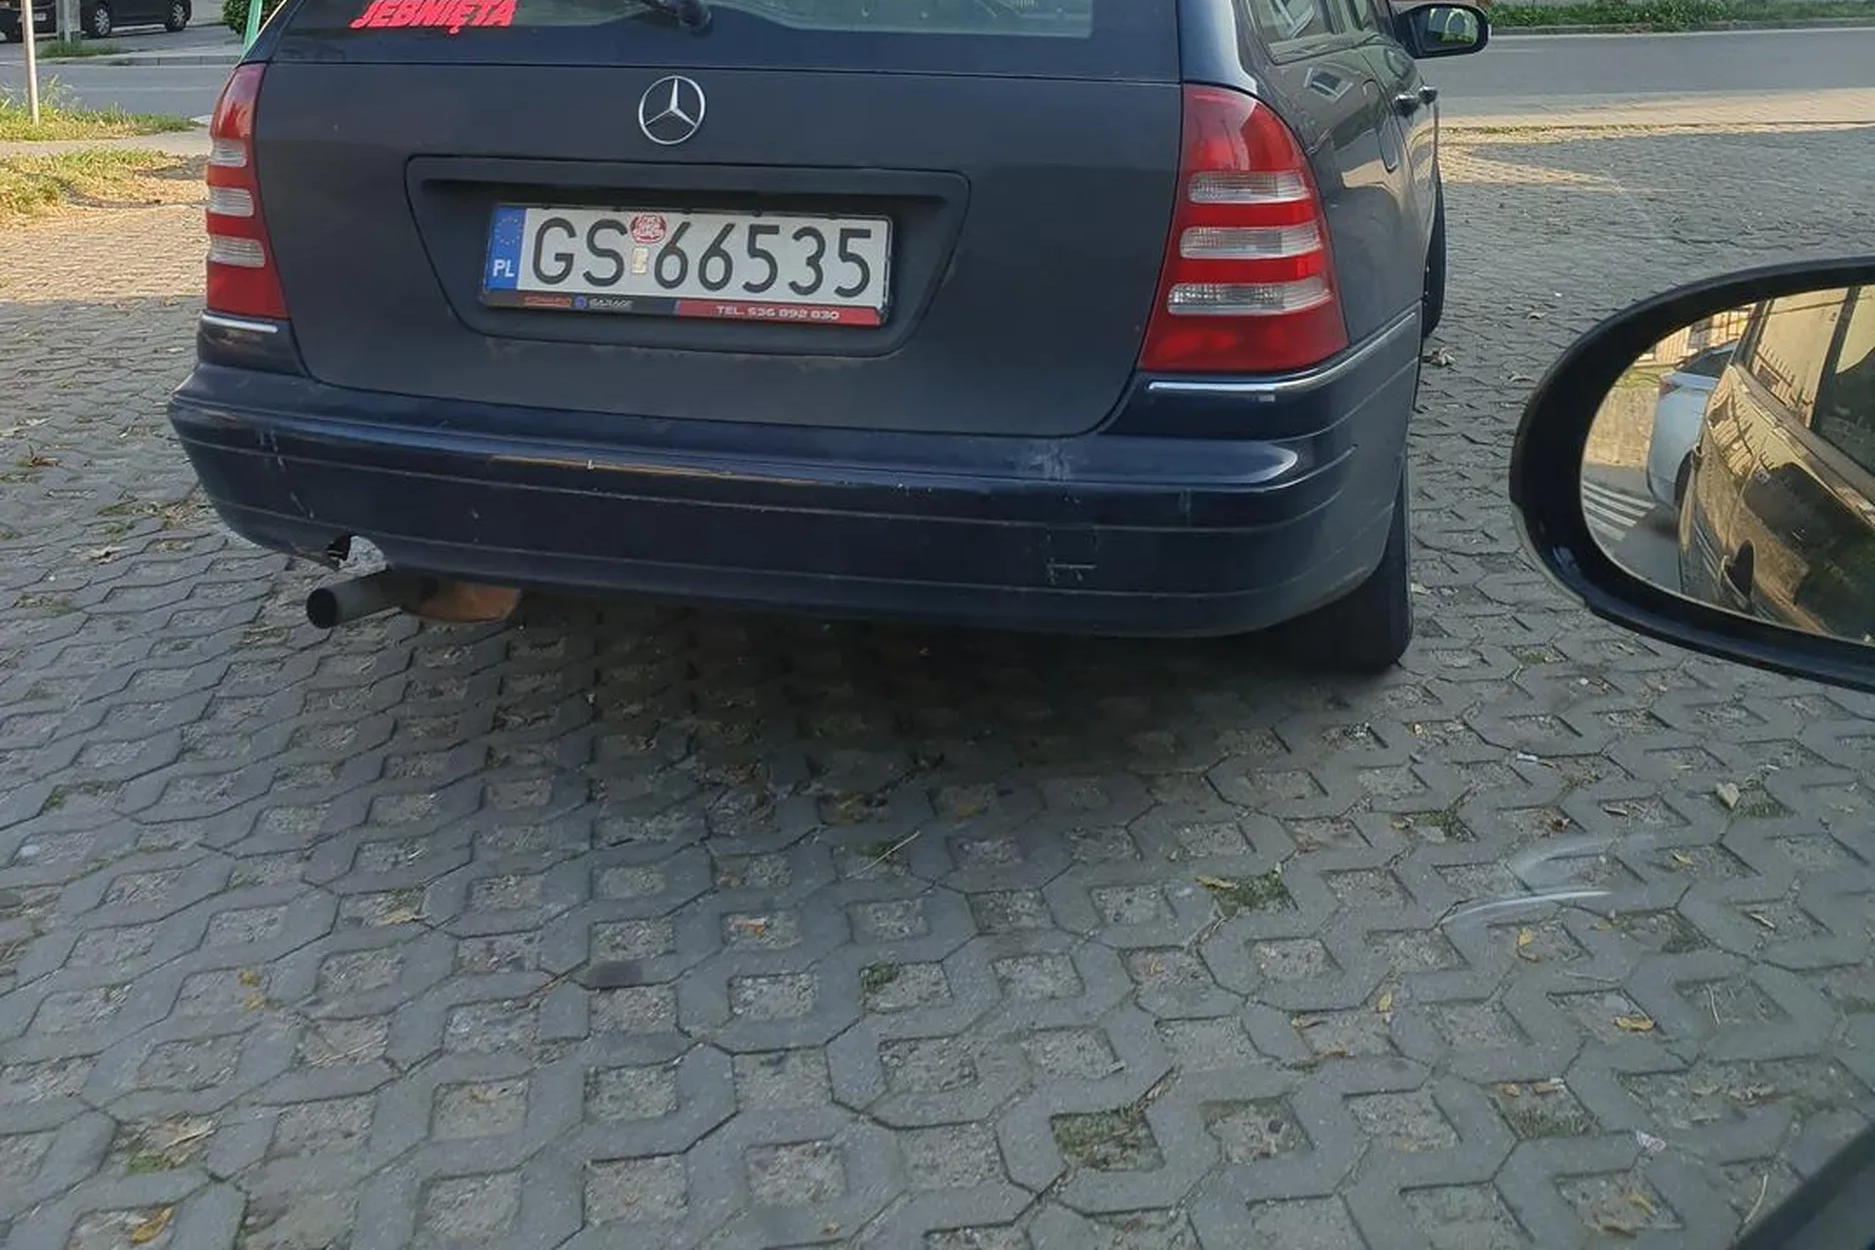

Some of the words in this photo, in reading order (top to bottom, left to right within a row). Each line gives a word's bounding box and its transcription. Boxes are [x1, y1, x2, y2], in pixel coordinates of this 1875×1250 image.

[532, 217, 628, 287] GS
[654, 221, 872, 298] 66535
[493, 259, 515, 277] PL
[716, 305, 745, 316] TEL.
